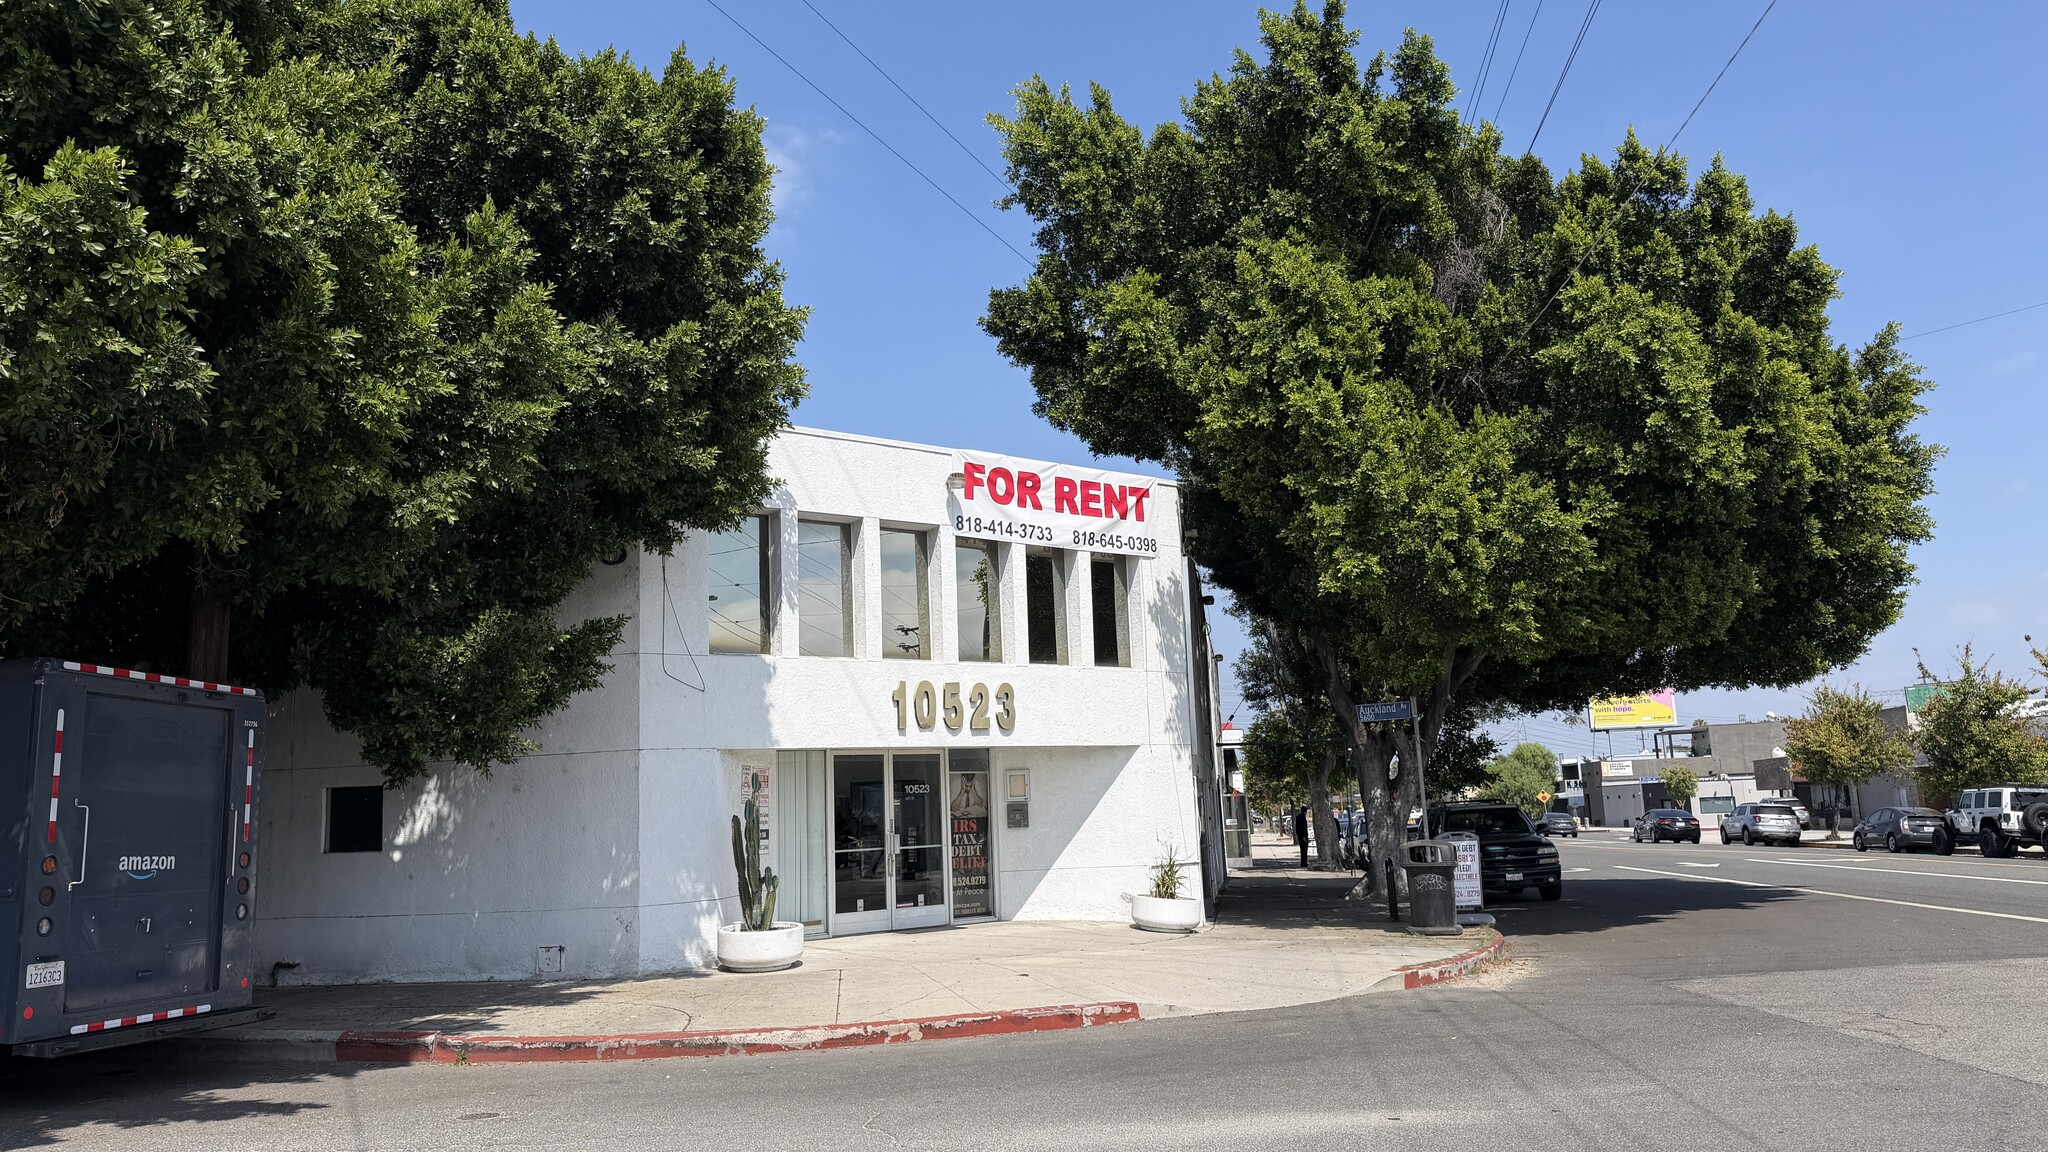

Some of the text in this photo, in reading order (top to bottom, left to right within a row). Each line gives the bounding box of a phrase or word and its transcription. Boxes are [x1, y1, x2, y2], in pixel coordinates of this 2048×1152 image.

[964, 462, 1150, 522] FOR RENT
[956, 515, 1053, 541] 818-414-3733
[1073, 529, 1157, 552] 818-645-0398
[892, 680, 1016, 731] 10523
[1360, 703, 1396, 715] Auckland
[1595, 705, 1612, 713] with
[904, 785, 930, 794] 10523
[953, 819, 977, 832] IRS
[953, 833, 977, 846] TAX
[952, 845, 982, 857] DEBT
[1462, 844, 1476, 852] DEBT
[119, 855, 176, 871] amazon
[952, 856, 987, 869] ELIEF
[965, 887, 984, 895] Peace
